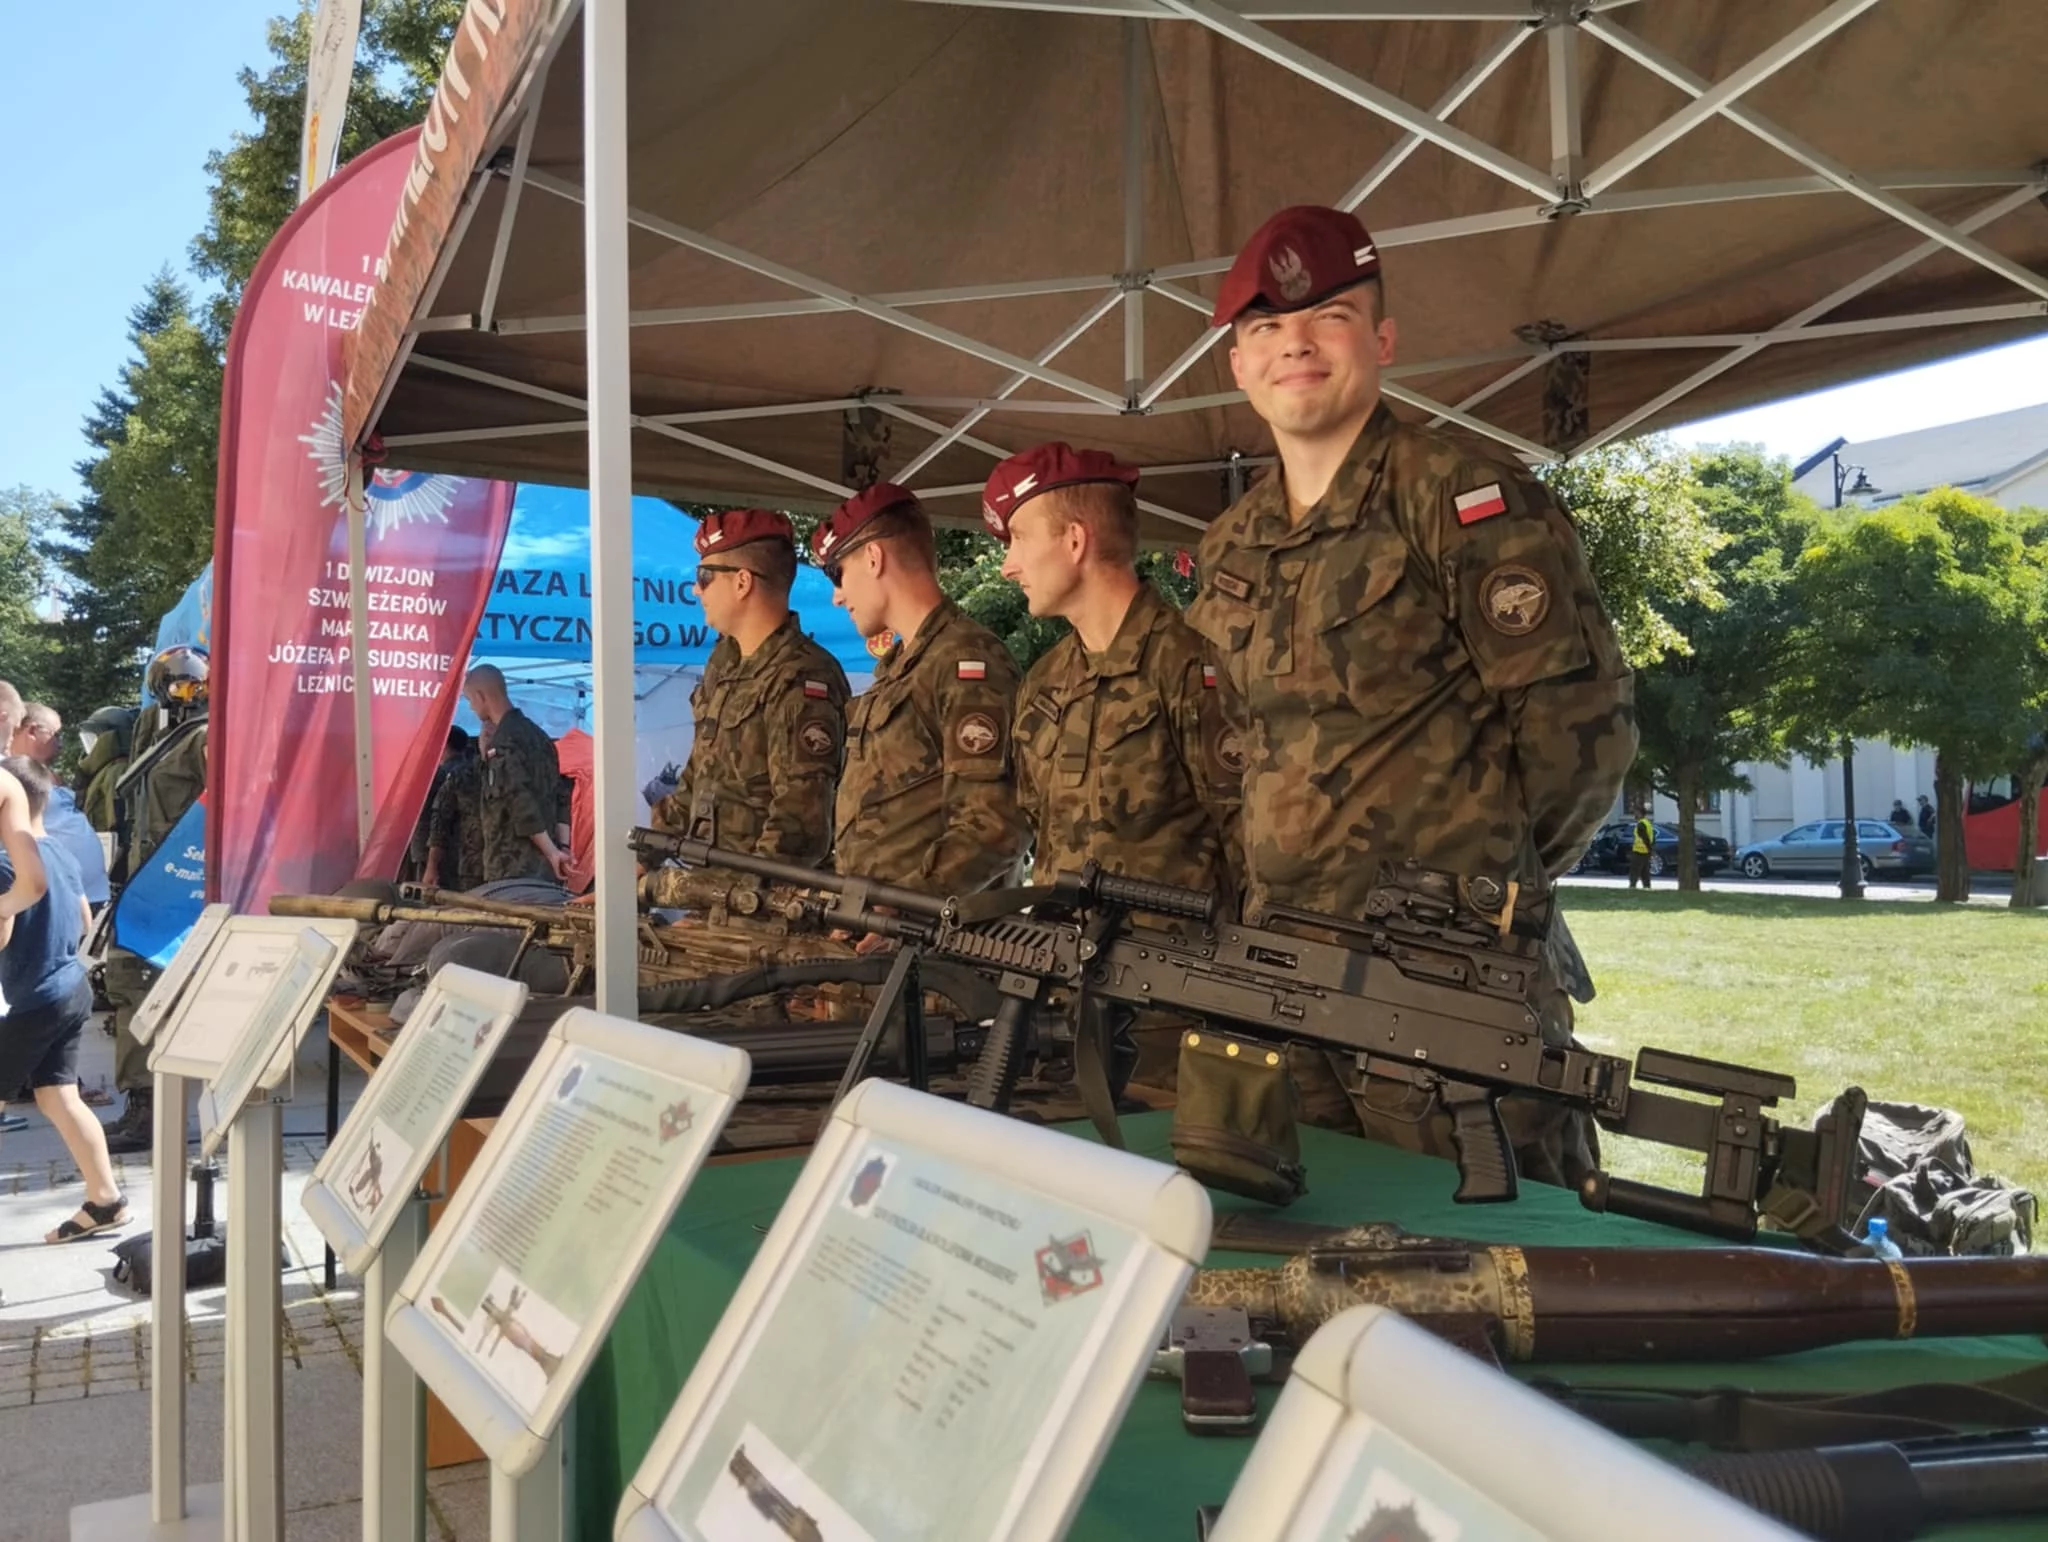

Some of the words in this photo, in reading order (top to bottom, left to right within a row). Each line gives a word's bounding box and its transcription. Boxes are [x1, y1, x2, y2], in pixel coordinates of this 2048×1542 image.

[304, 302, 324, 323] W
[328, 307, 363, 331] LEŹ
[325, 561, 332, 579] 1
[338, 562, 434, 587] DWIZJON
[496, 568, 569, 598] AZA
[578, 572, 697, 606] LNIC
[308, 588, 448, 616] SZWEŻERÓW
[321, 618, 430, 643] MARZAŁKA
[478, 612, 671, 648] TYCZNGO
[268, 640, 335, 665] JÓZEFA
[338, 646, 453, 672] PSUDSKIE
[297, 671, 354, 694] LEŹNIC
